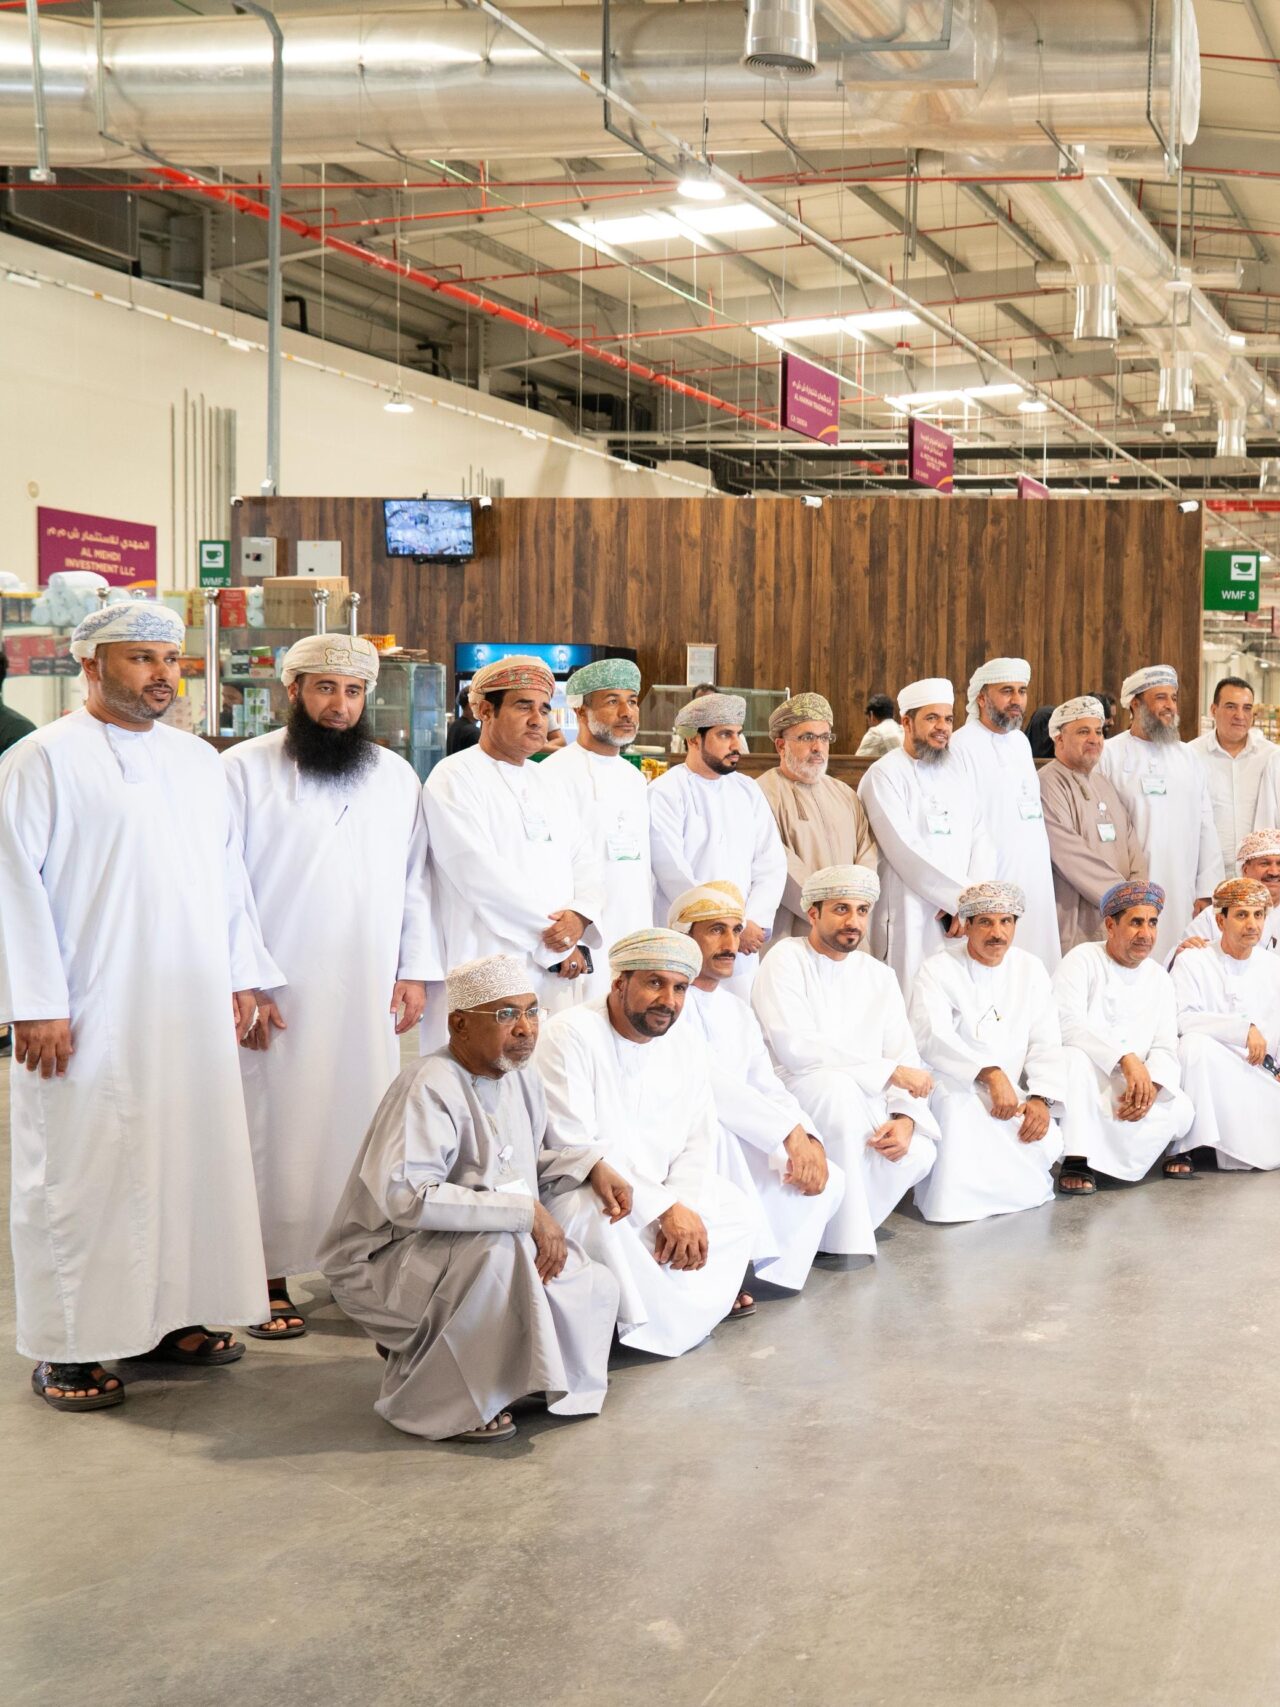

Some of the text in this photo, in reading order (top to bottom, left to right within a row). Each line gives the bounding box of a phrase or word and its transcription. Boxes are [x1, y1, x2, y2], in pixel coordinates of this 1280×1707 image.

[119, 538, 150, 551] المهدي
[80, 547, 121, 562] AL MEHDI
[64, 557, 136, 577] INVESTMENT LLC
[201, 577, 232, 586] WMF 3
[1221, 590, 1256, 601] WMF 3
